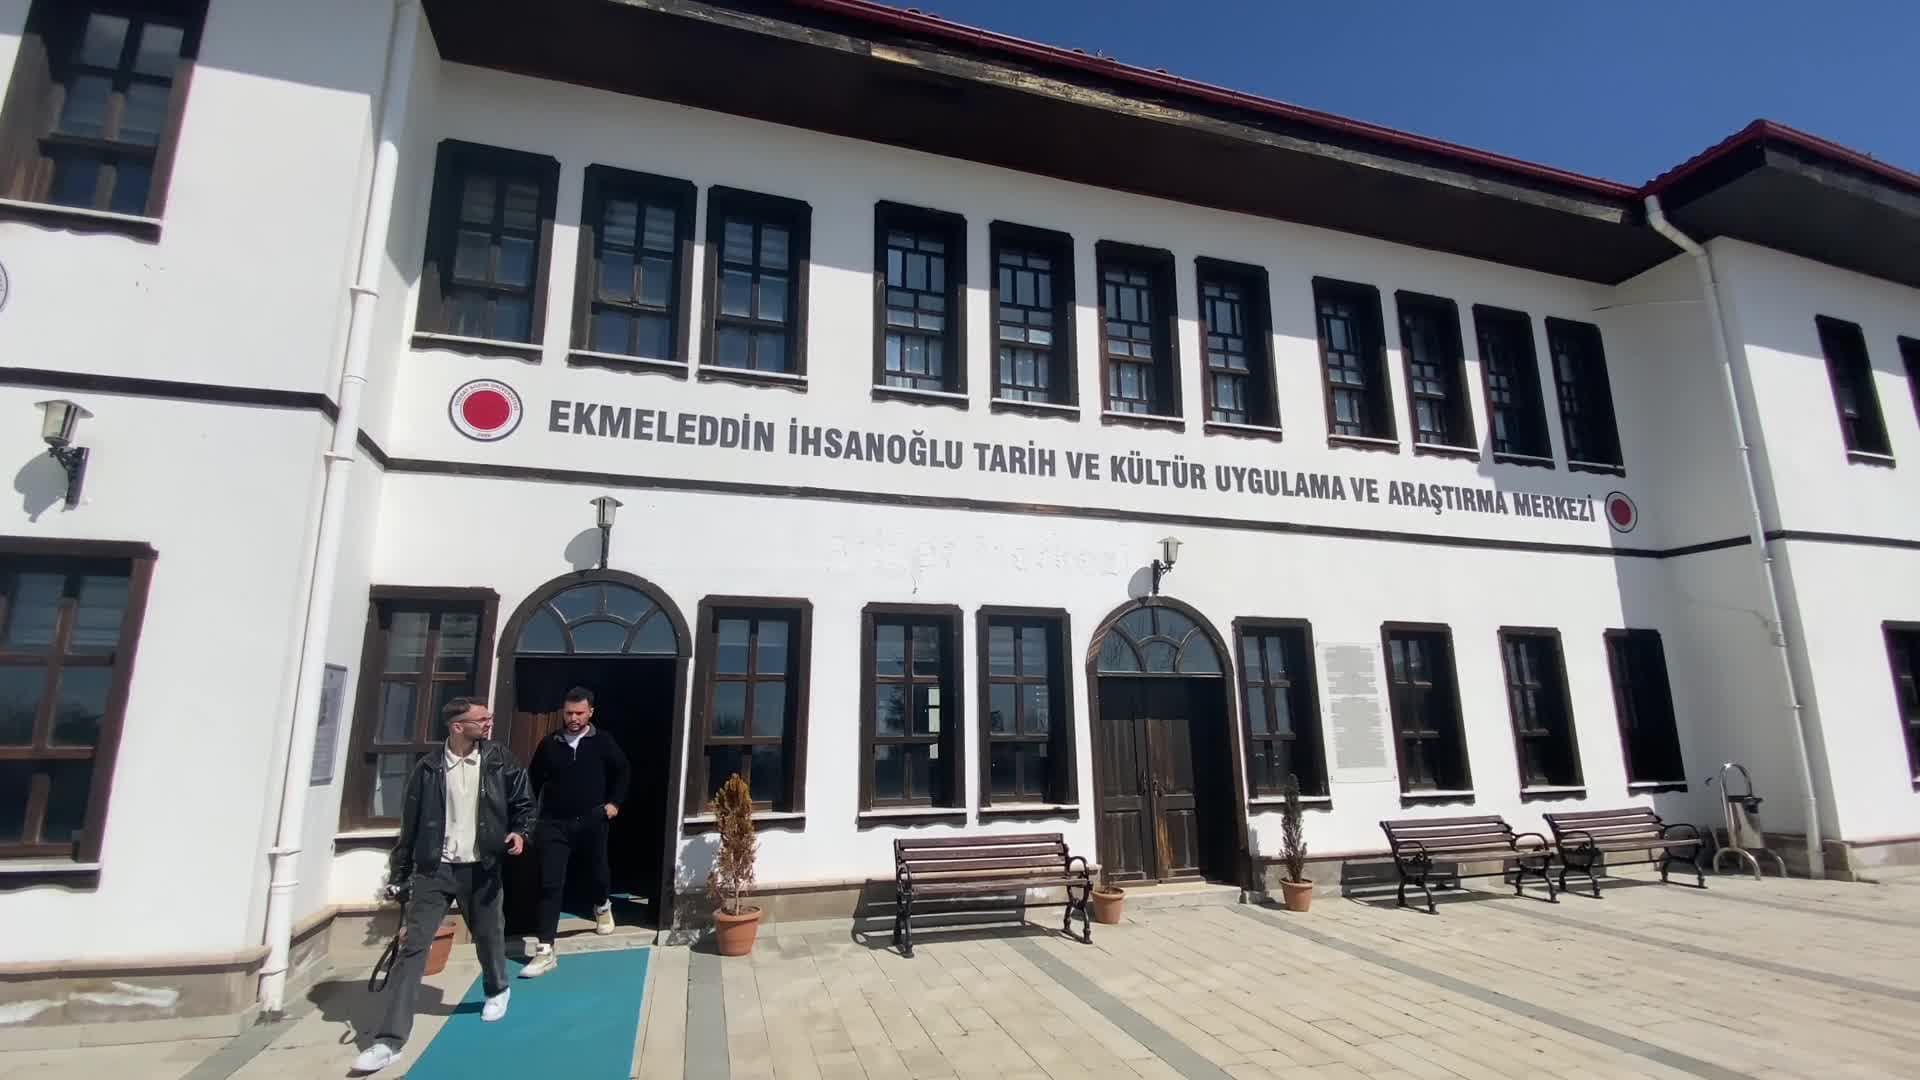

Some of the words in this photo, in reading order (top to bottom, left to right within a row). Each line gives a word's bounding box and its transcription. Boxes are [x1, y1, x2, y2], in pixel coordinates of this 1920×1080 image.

[548, 399, 775, 453] EKMELEDDİN
[788, 417, 964, 470] İHSANOĞLU
[972, 440, 1057, 477] TARİH
[1066, 450, 1101, 481] VE
[1110, 449, 1208, 491] KÜLTÜR
[1214, 464, 1347, 503] UYGULAMA
[1350, 476, 1380, 504] VE
[1388, 480, 1510, 516] ARAŞTIRMA
[1513, 491, 1596, 523] MERKEZİ
